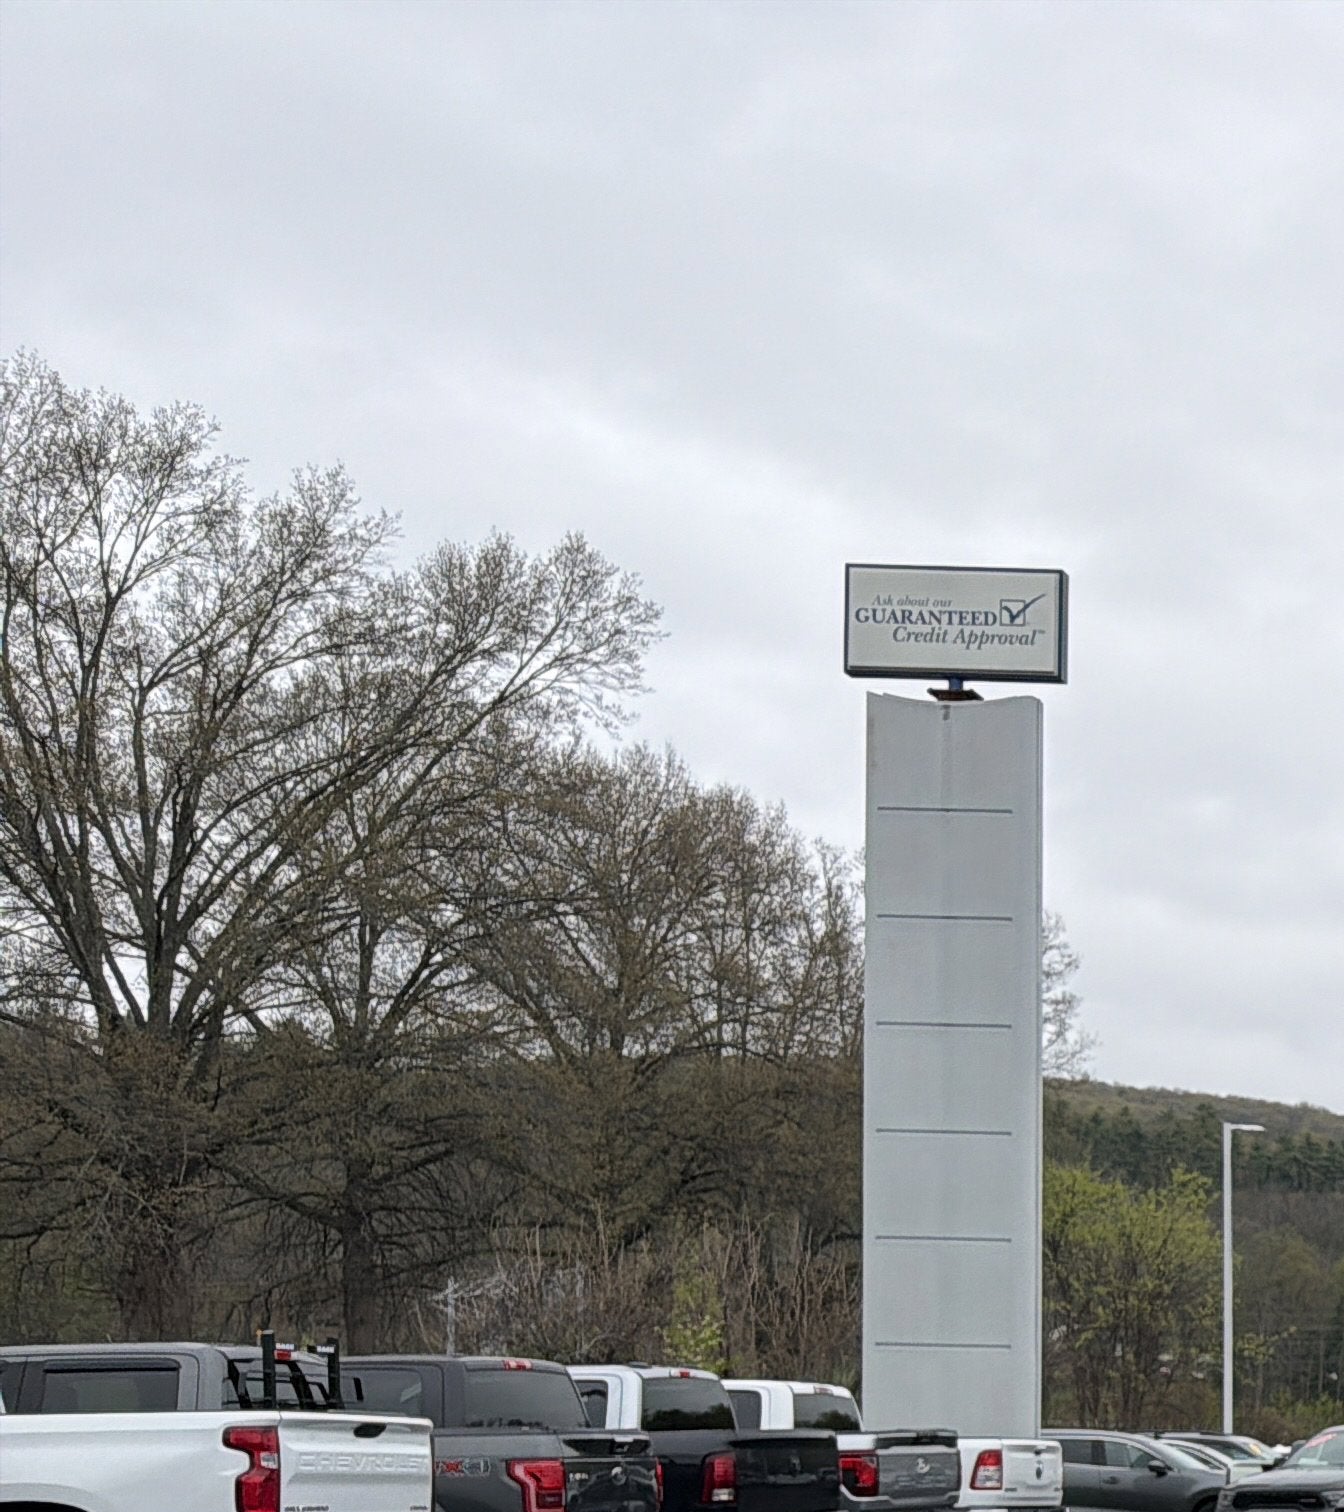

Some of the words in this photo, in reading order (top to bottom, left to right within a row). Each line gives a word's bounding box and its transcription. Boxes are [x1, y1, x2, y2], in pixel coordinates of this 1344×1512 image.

[872, 594, 893, 606] Ask
[897, 595, 930, 607] about
[933, 599, 954, 608] our
[855, 607, 997, 627] GUARANTEED
[892, 626, 949, 643] Credit
[299, 1454, 429, 1472] CHEVROLET
